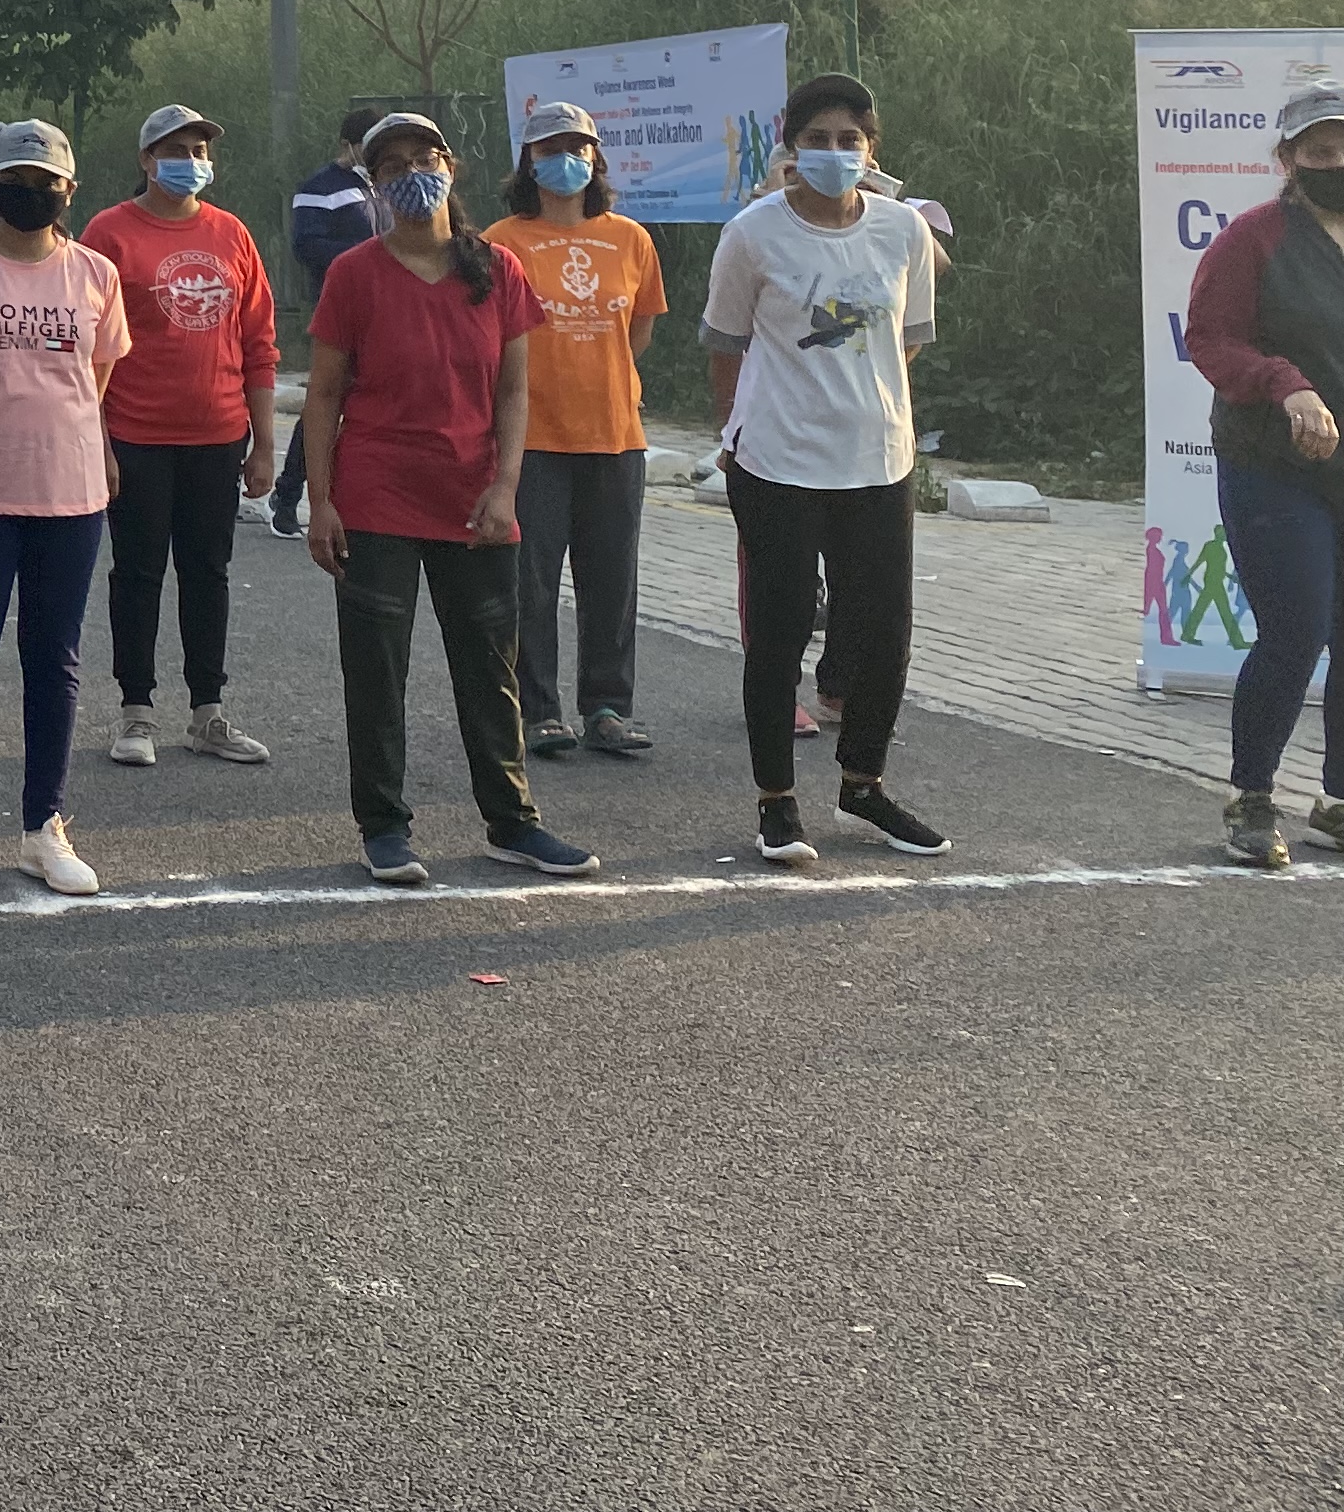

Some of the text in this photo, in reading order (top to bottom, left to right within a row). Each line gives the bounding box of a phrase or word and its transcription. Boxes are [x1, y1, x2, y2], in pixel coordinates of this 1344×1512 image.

[1154, 108, 1266, 133] Vigilance
[598, 120, 703, 147] thon and Walkathon
[1154, 162, 1233, 175] Independent
[1238, 162, 1270, 175] India
[548, 238, 569, 247] OLD
[159, 255, 181, 280] ROCKY
[1184, 461, 1213, 475] Asia
